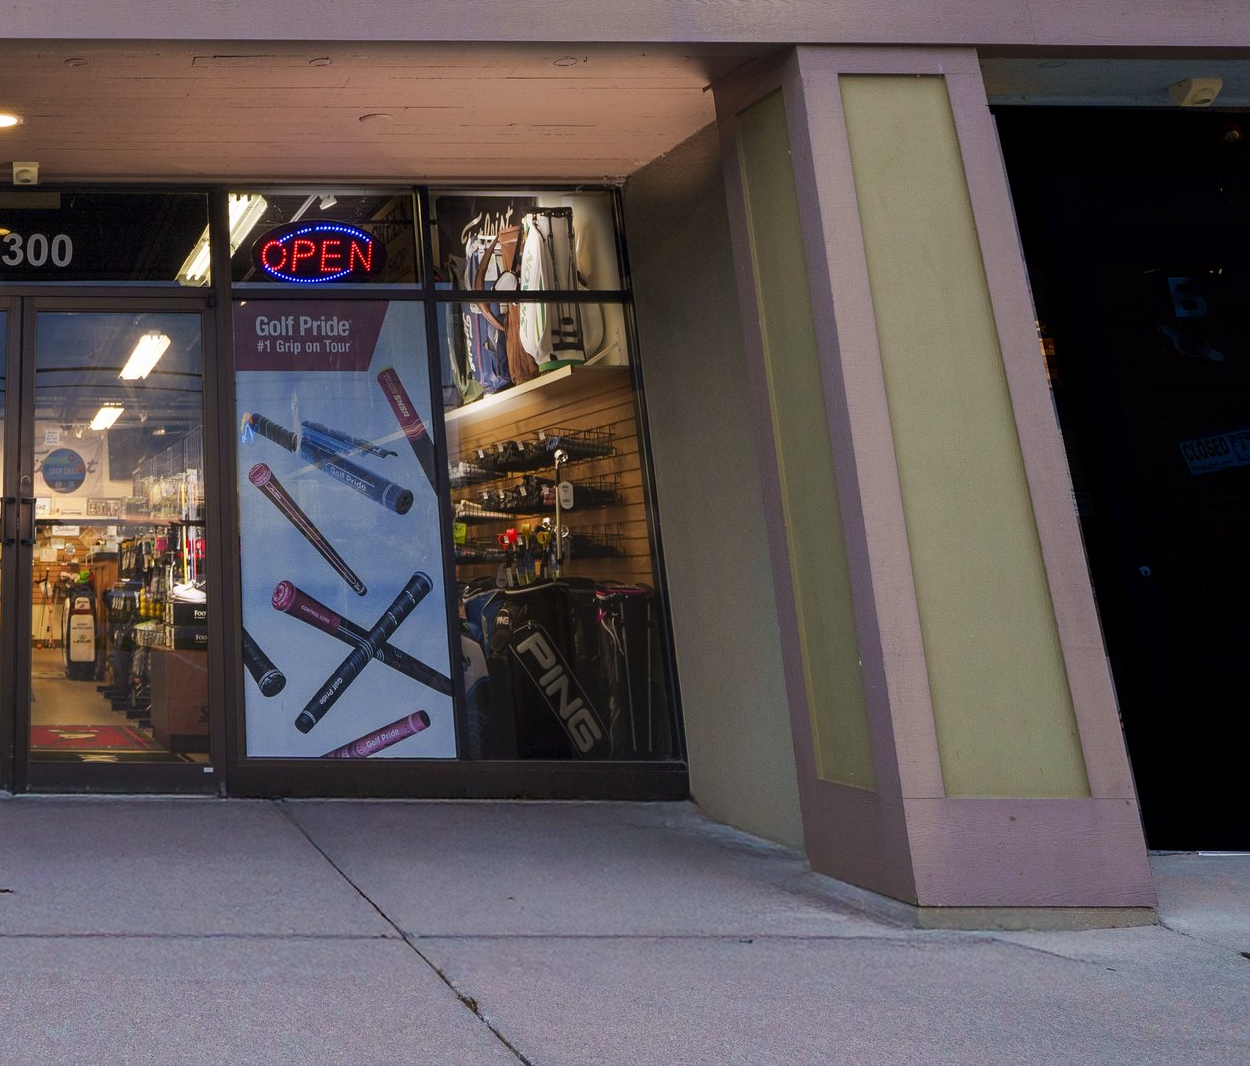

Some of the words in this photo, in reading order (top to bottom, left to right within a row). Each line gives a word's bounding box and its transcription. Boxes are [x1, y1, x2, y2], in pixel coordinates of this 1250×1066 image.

[262, 239, 372, 272] OPEN
[255, 316, 294, 336] Golf
[299, 316, 350, 336] Pride
[257, 341, 270, 352] #1
[276, 340, 301, 354] Grip
[305, 342, 320, 352] on
[324, 340, 350, 352] Tour
[394, 395, 410, 417] SNSR
[1183, 435, 1229, 463] CLOSED
[346, 474, 368, 492] Pride
[516, 632, 602, 753] PING
[381, 728, 400, 742] Pride
